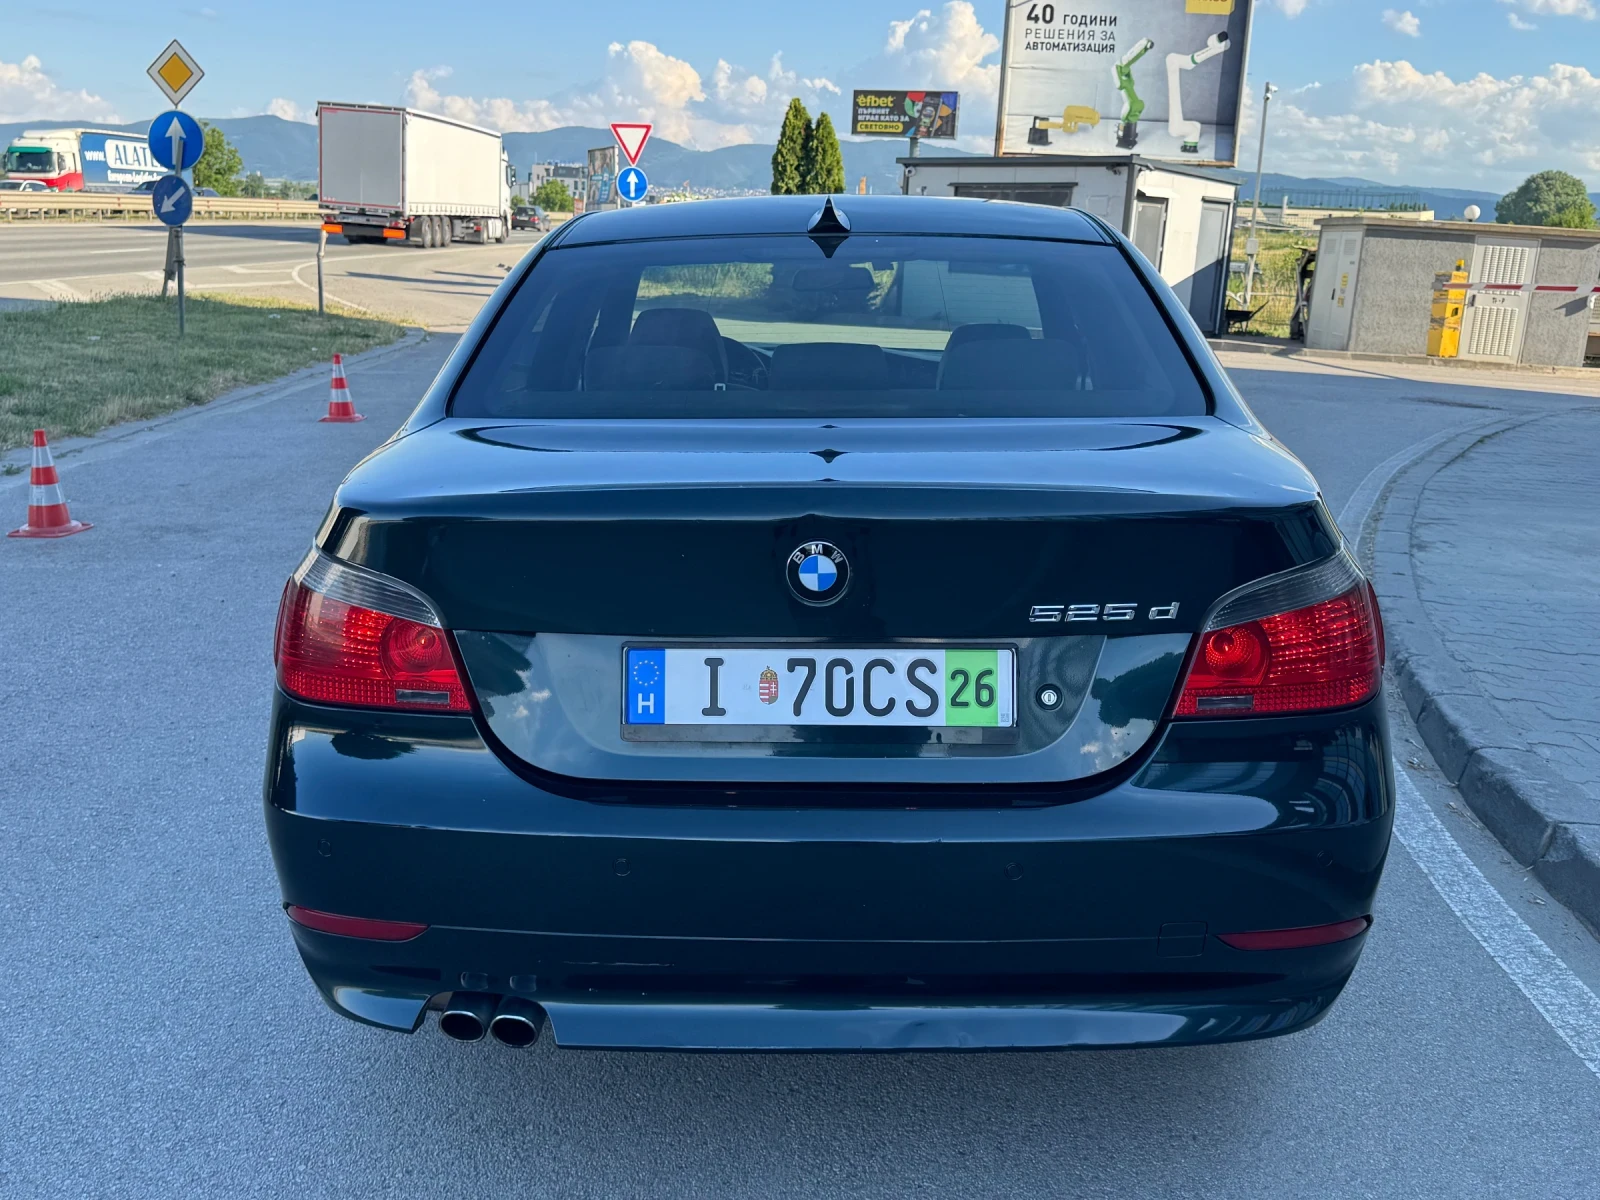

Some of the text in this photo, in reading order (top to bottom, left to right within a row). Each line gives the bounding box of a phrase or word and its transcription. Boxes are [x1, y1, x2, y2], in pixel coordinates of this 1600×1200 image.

[1026, 4, 1118, 27] 40 ГОДИНИ
[1025, 28, 1116, 42] РЕШЕНИЯ ЗА
[1025, 41, 1116, 55] АВТОМАТИЗАЦИЯ
[858, 94, 894, 107] efbet
[792, 544, 844, 564] BMW
[1029, 601, 1180, 622] 525 d
[786, 657, 940, 718] 70CS
[950, 669, 995, 708] 26
[637, 693, 655, 714] H
